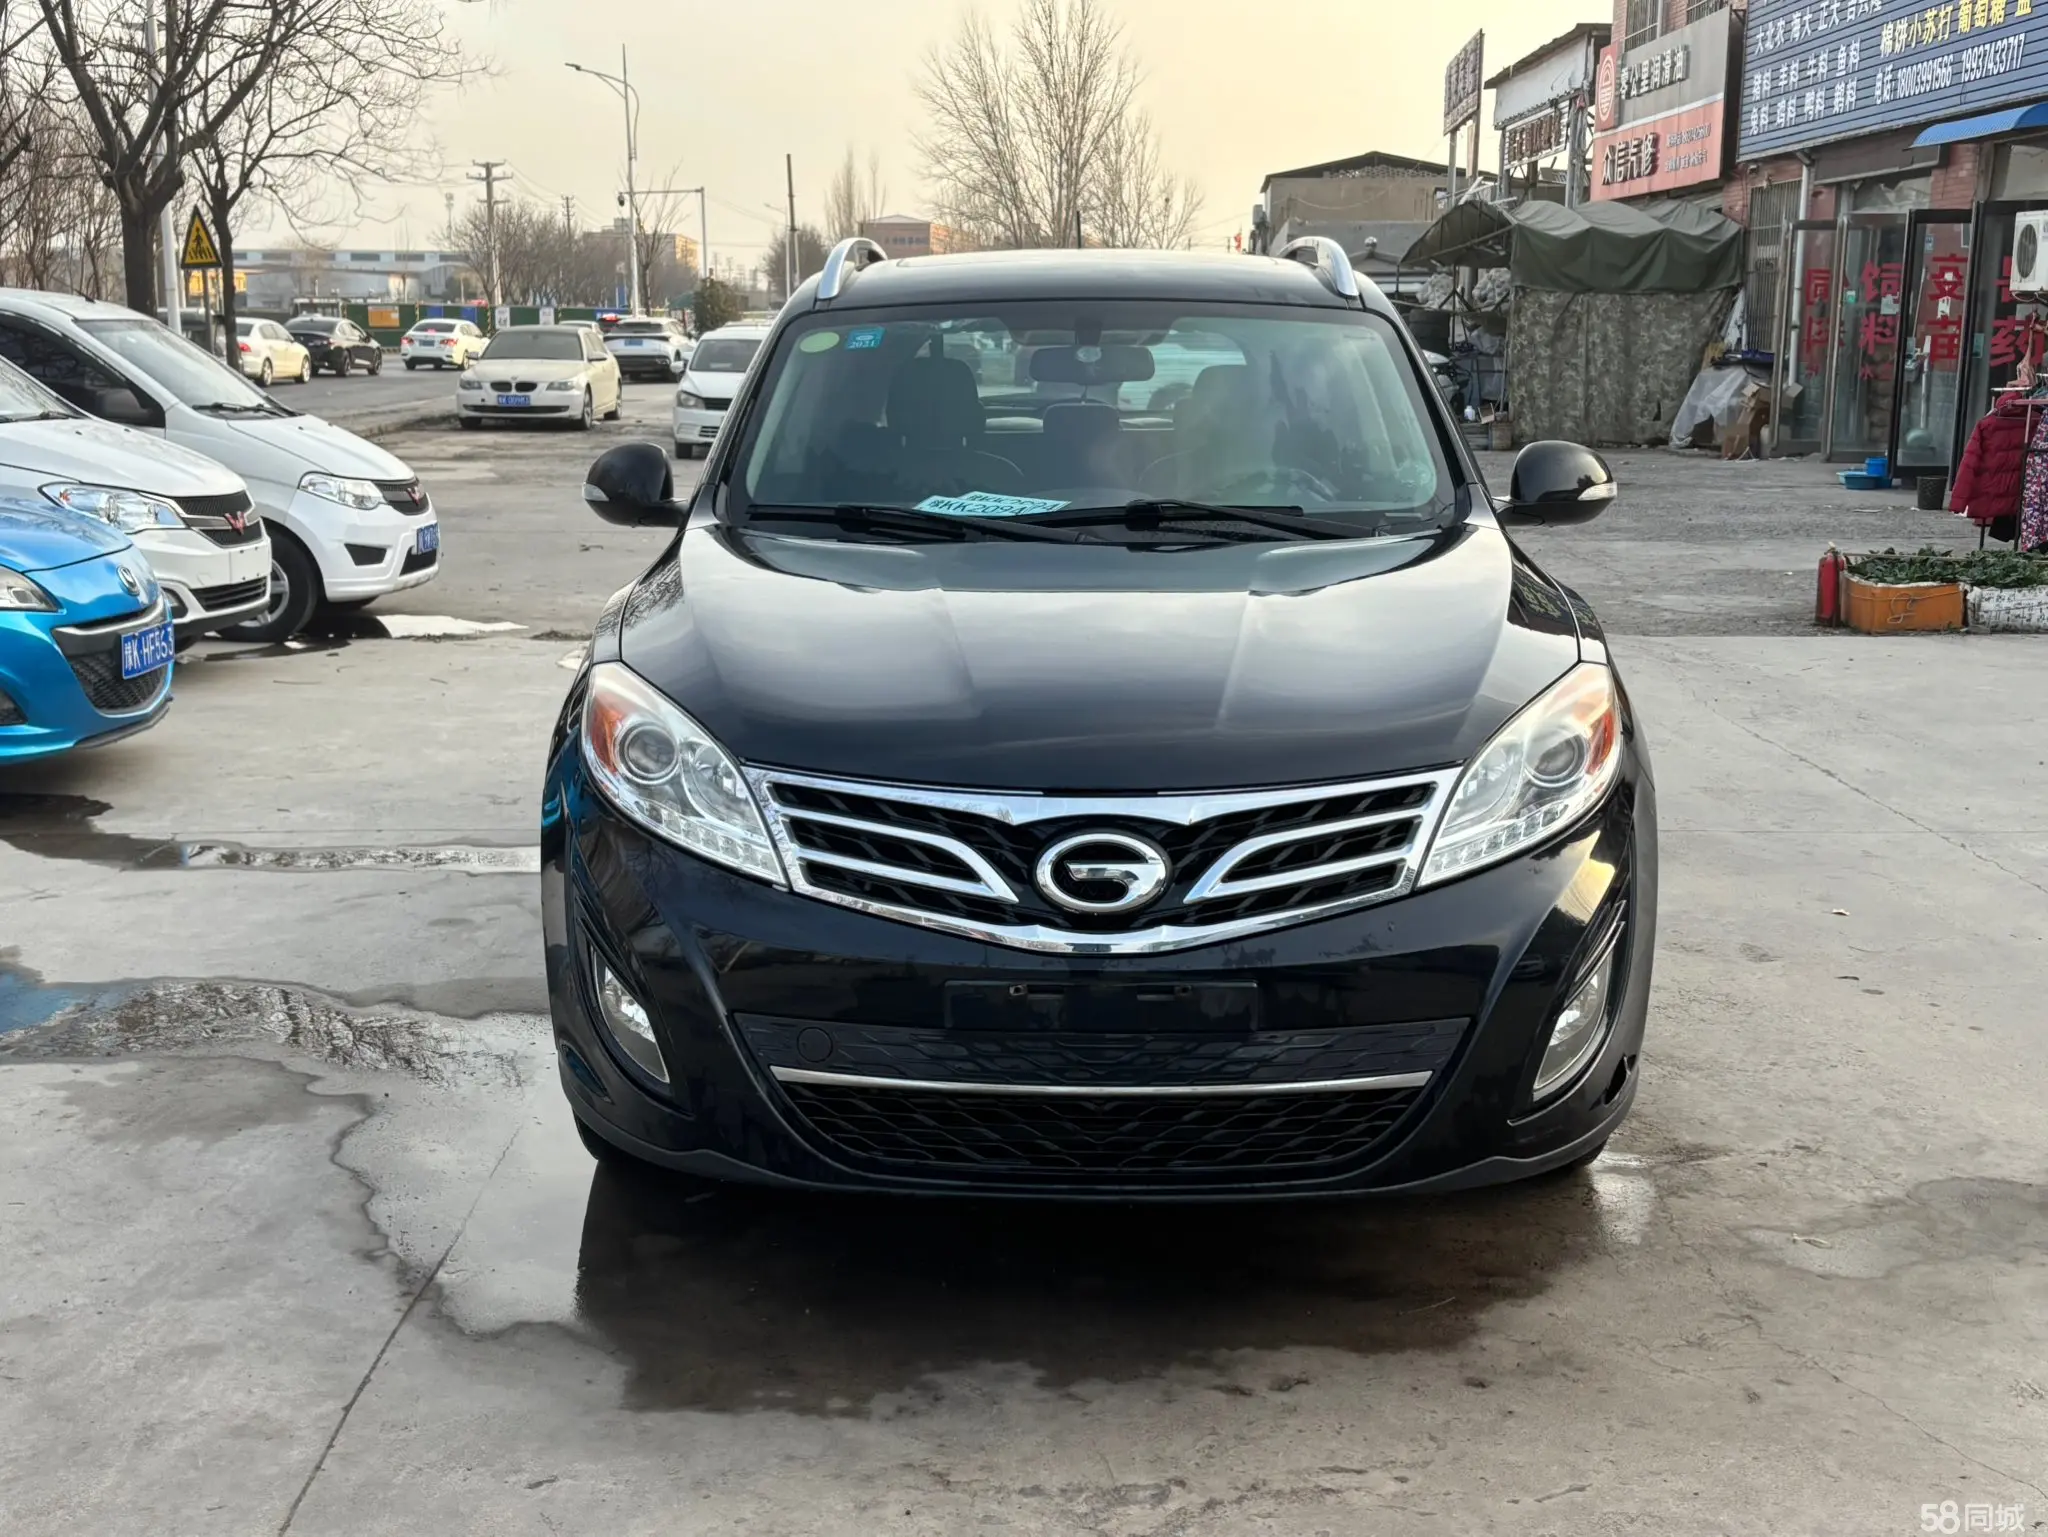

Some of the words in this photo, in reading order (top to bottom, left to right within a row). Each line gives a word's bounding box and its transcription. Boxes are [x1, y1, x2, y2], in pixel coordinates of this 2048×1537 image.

[1755, 18, 1786, 55] 大北农
[1962, 33, 2026, 82] 19937433717
[1619, 46, 1686, 100] 零公里润滑油
[1778, 59, 1800, 93] 羊料
[1807, 48, 1829, 85] 牛料
[1836, 37, 1861, 77] 鱼料
[1602, 132, 1658, 184] 众信汽修
